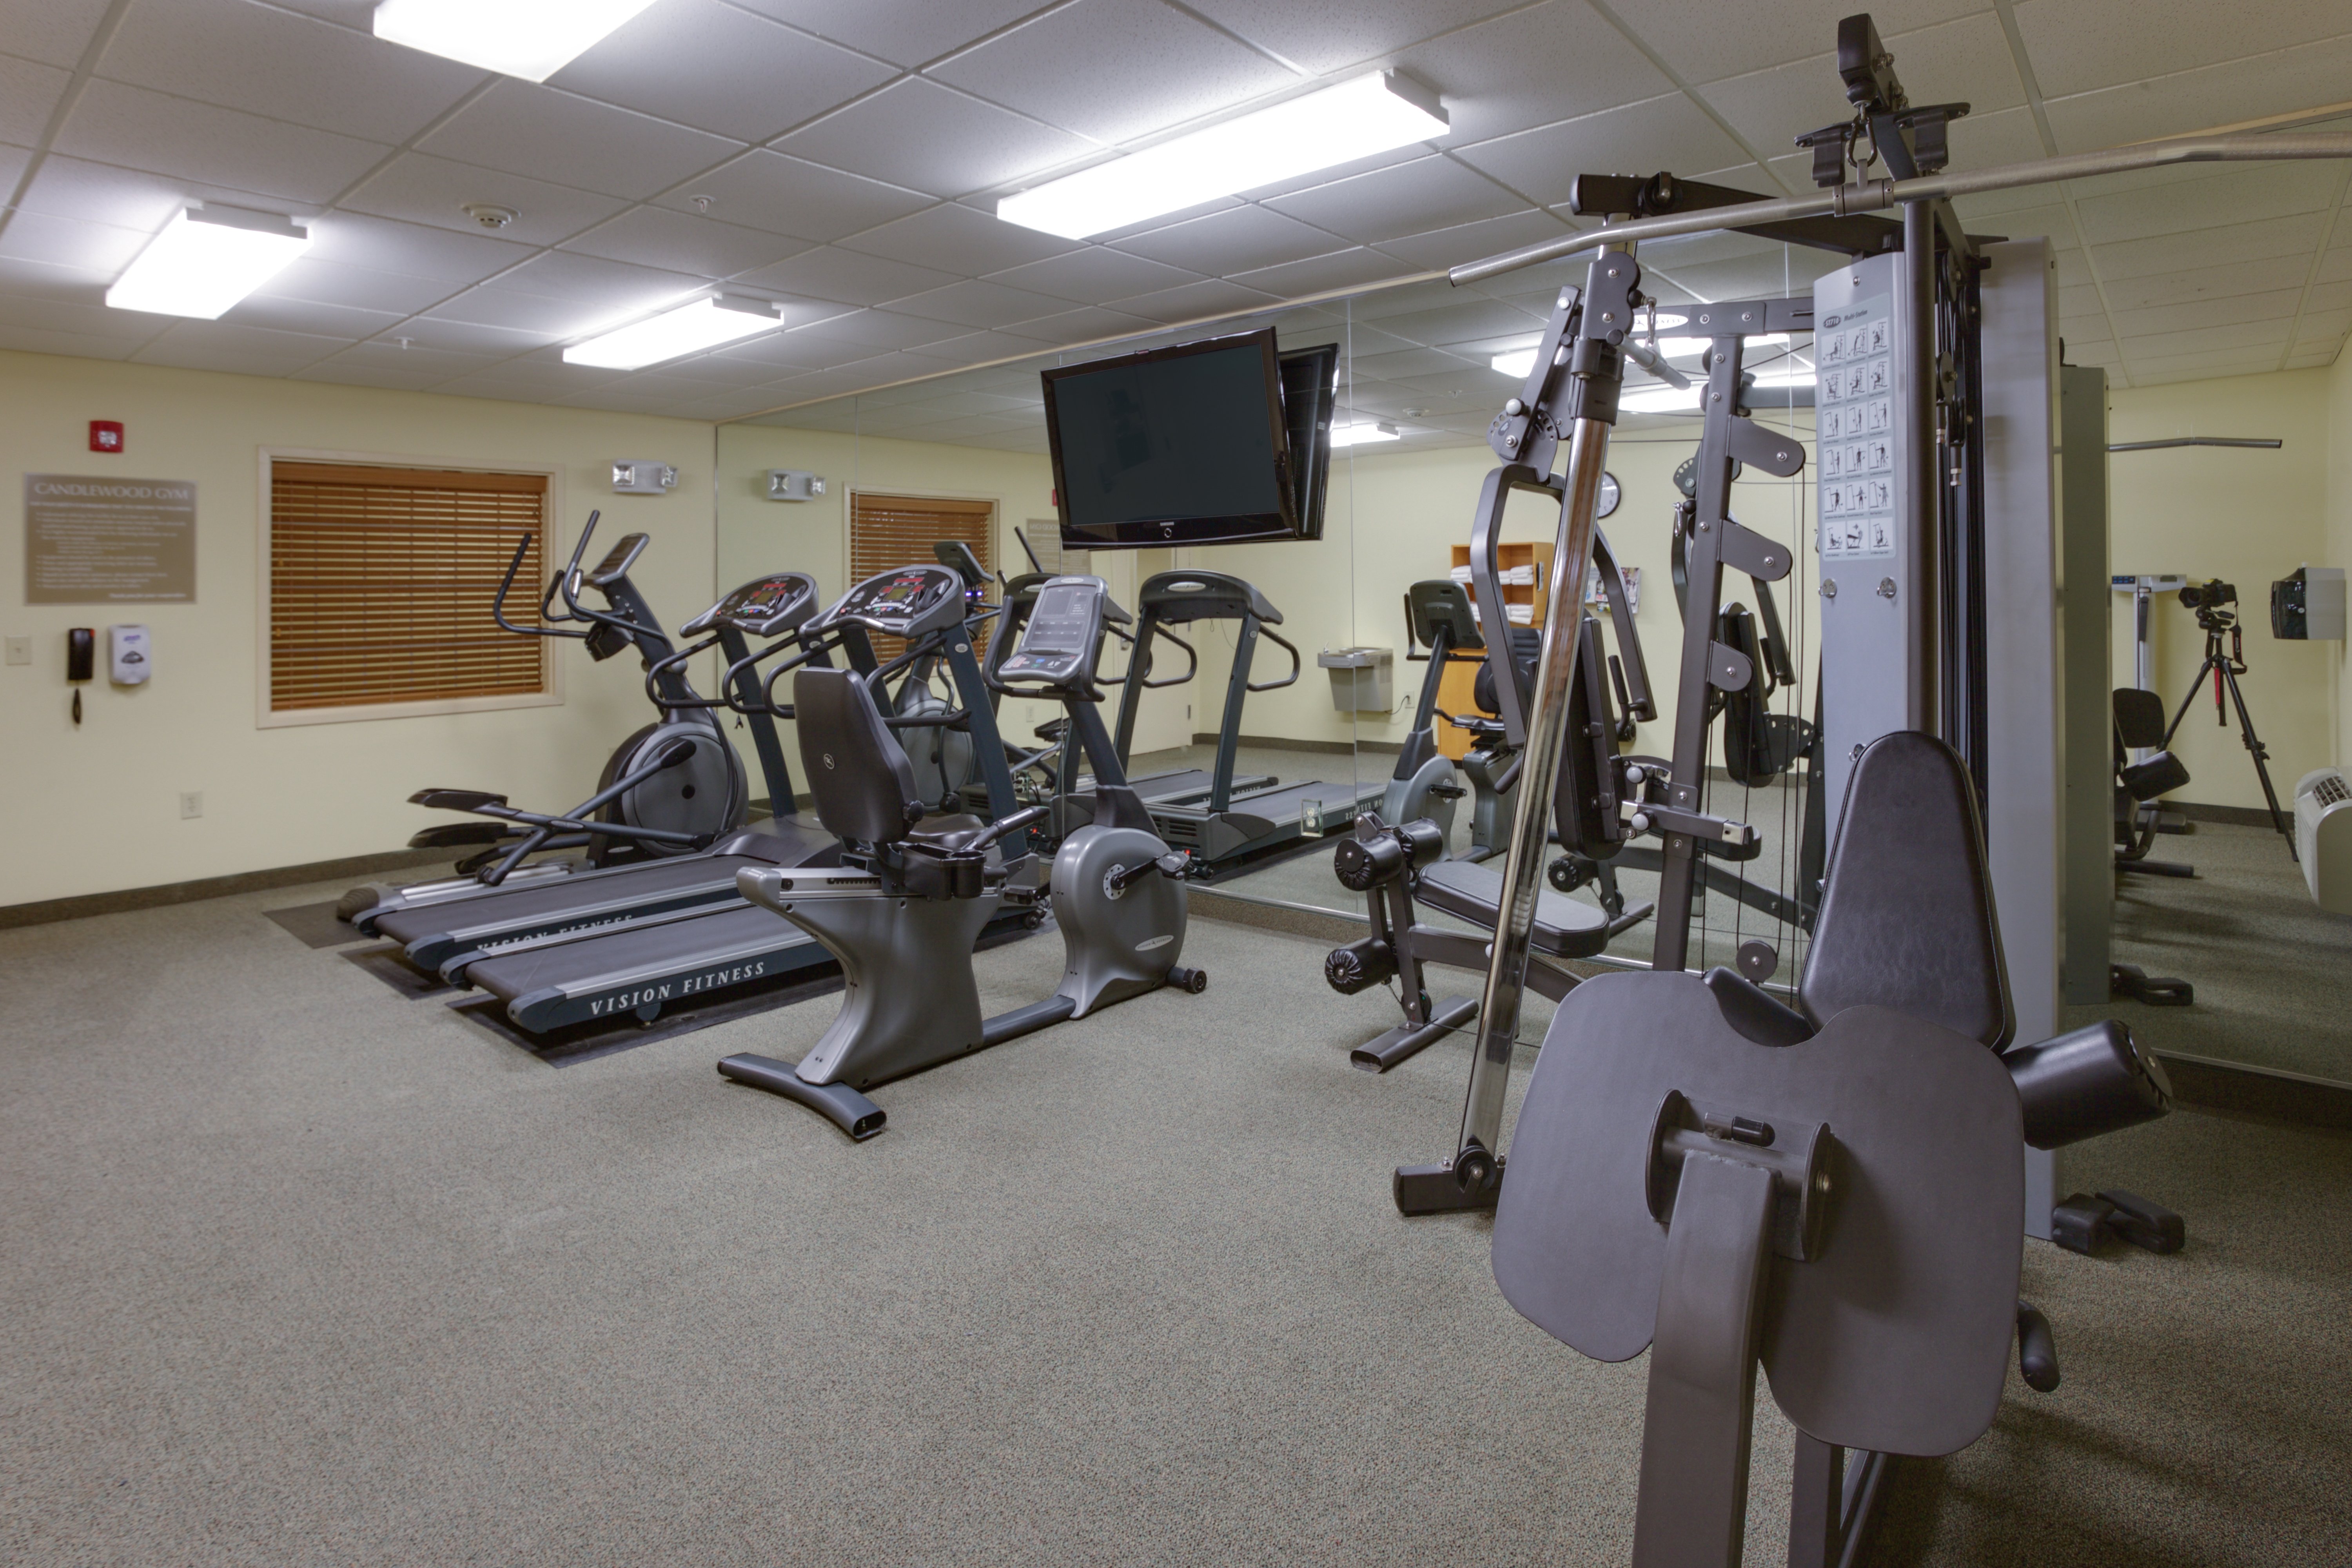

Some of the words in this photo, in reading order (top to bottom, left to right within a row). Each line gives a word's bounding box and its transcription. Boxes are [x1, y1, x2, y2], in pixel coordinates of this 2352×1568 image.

[34, 483, 152, 498] CANDLEWOOD
[155, 487, 189, 499] GYM
[590, 984, 671, 1015] VISION
[682, 962, 764, 993] FITNESS
